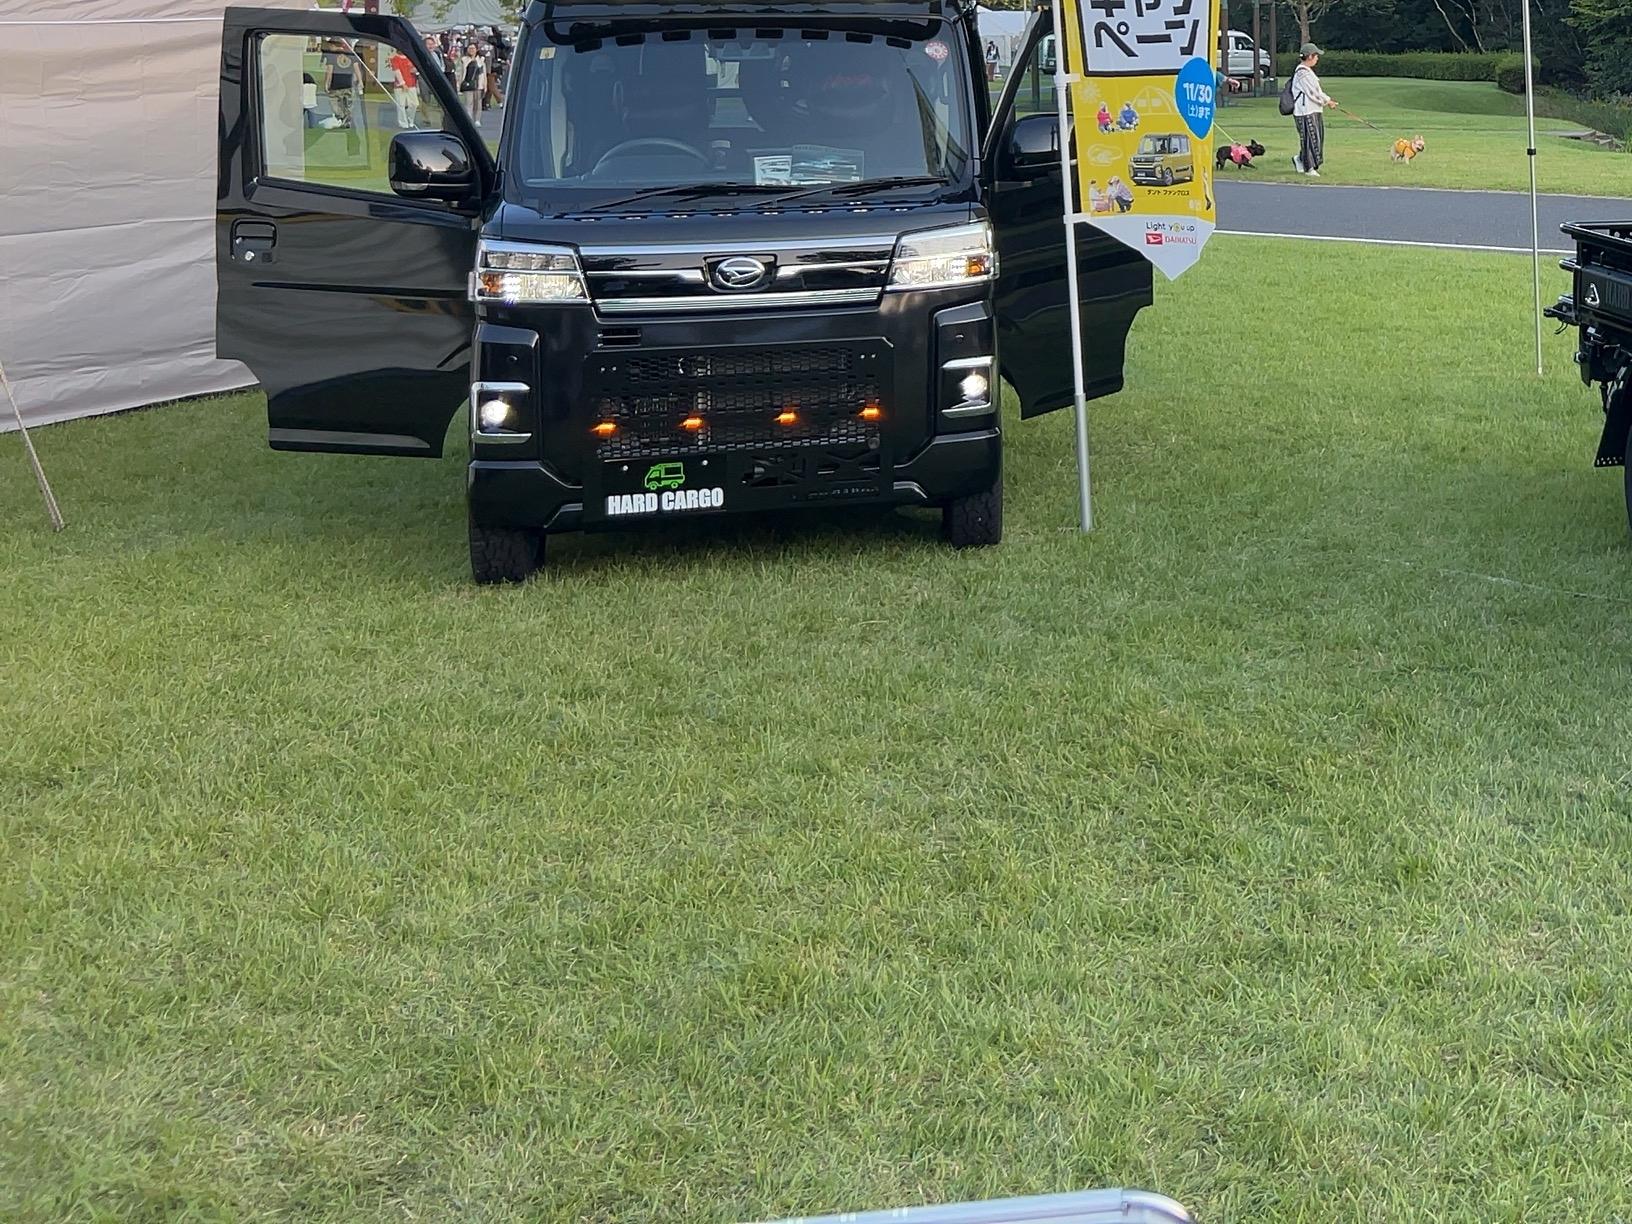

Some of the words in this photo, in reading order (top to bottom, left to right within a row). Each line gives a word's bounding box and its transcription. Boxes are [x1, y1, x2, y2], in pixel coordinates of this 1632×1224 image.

[1183, 82, 1212, 104] 11/30
[1146, 222, 1166, 232] Light
[1165, 236, 1197, 245] DAIHATSU
[1605, 279, 1630, 310] HARD
[607, 493, 657, 515] HARD
[662, 487, 725, 512] CARGO
